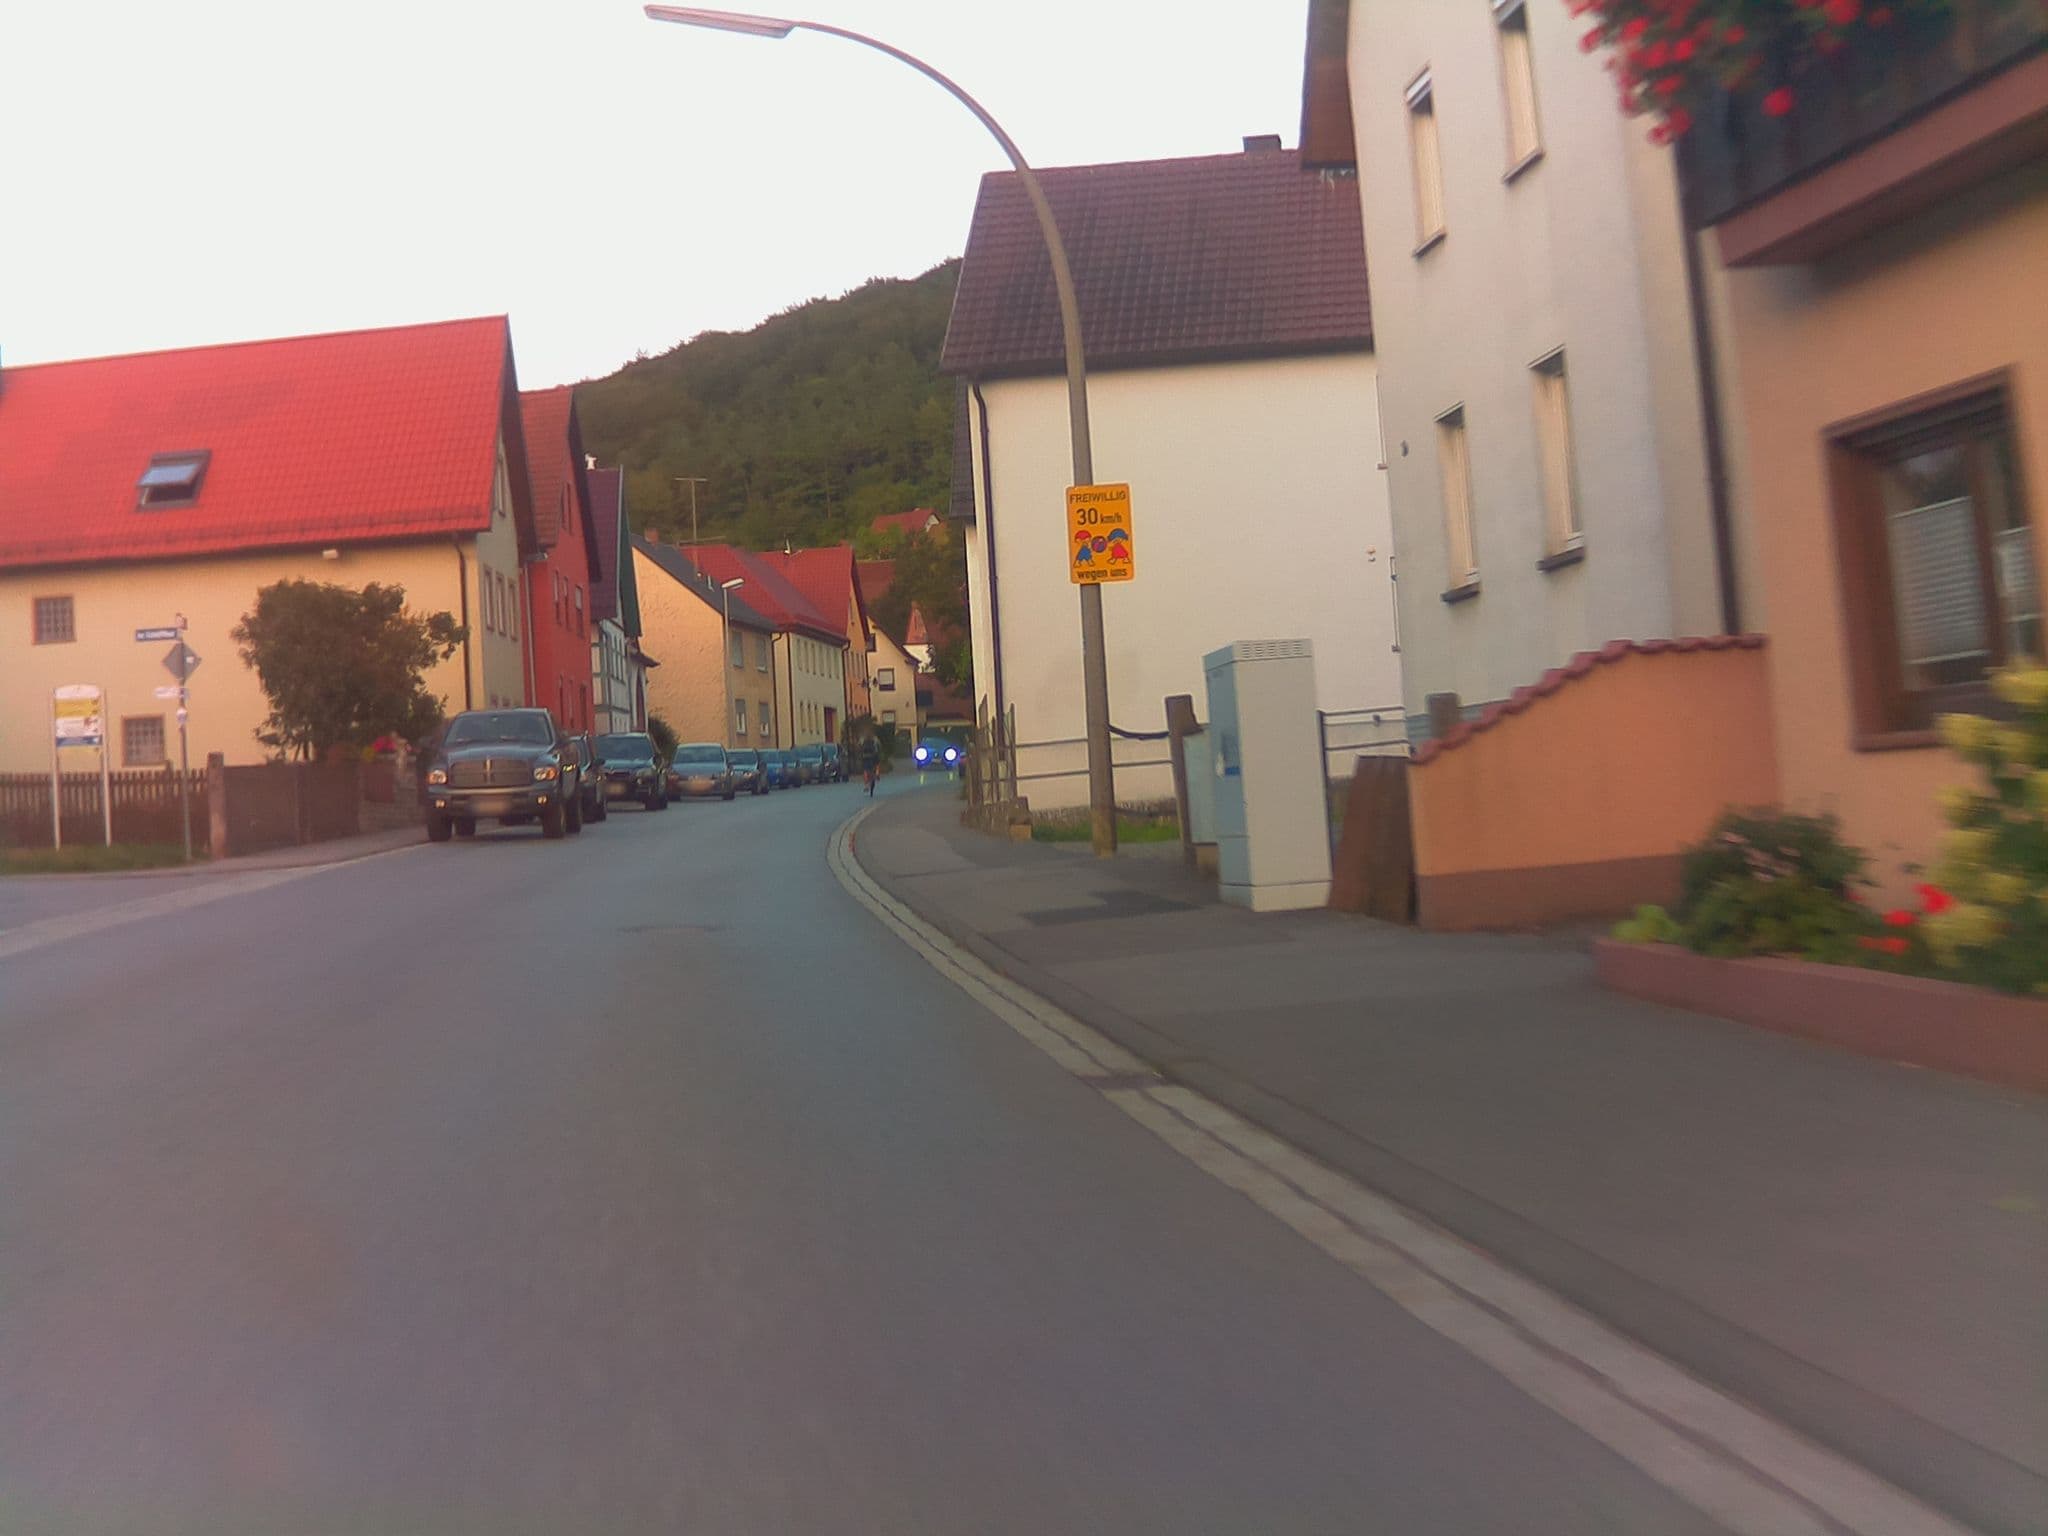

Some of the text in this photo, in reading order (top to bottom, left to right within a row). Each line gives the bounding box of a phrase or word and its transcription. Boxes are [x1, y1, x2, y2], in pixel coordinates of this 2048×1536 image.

[1069, 490, 1126, 503] FREIWILLIG
[1076, 508, 1122, 525] 30 km/h
[1077, 568, 1127, 580] wegen uns
